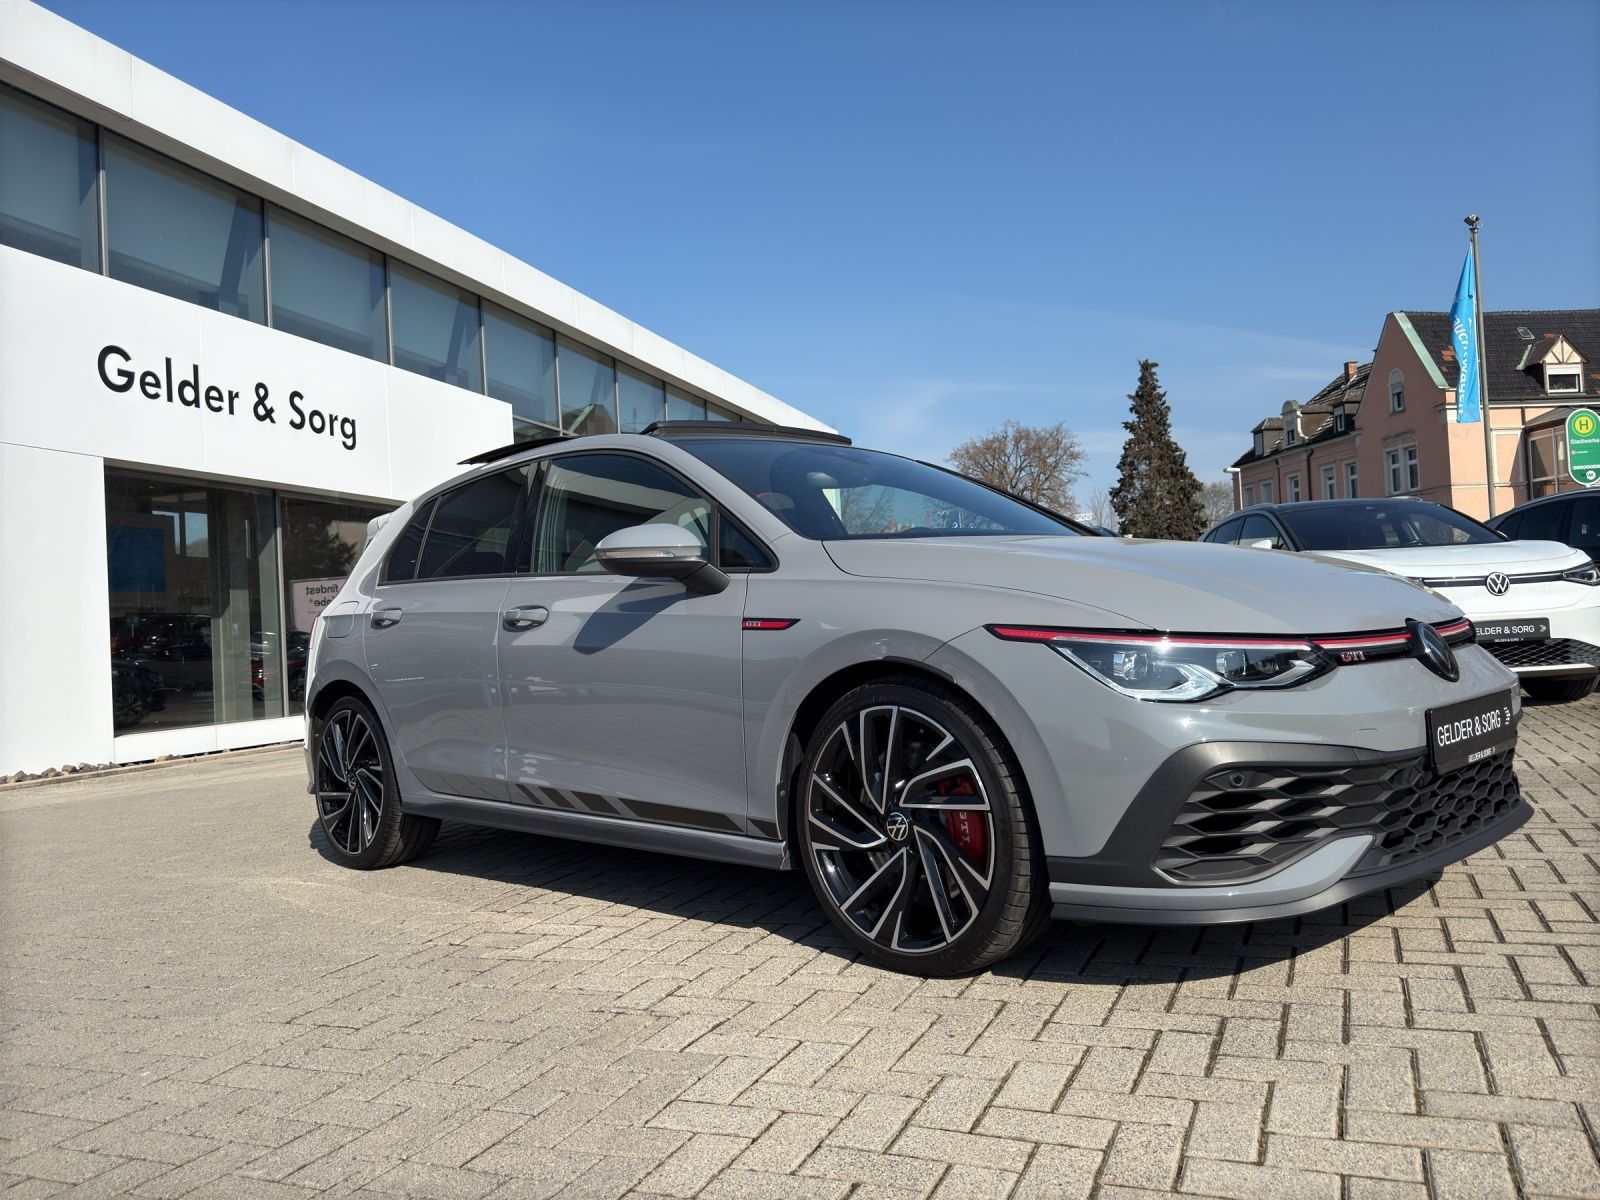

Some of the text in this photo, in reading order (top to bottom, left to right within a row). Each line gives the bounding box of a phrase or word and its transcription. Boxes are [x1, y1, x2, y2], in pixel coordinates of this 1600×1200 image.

[97, 345, 357, 450] Gelder & Sorg
[1579, 419, 1589, 430] H
[1475, 625, 1535, 636] ELDER & SORG
[1341, 651, 1366, 662] GTI
[1437, 709, 1501, 747] GELDER & SORG
[959, 811, 970, 843] GTI
